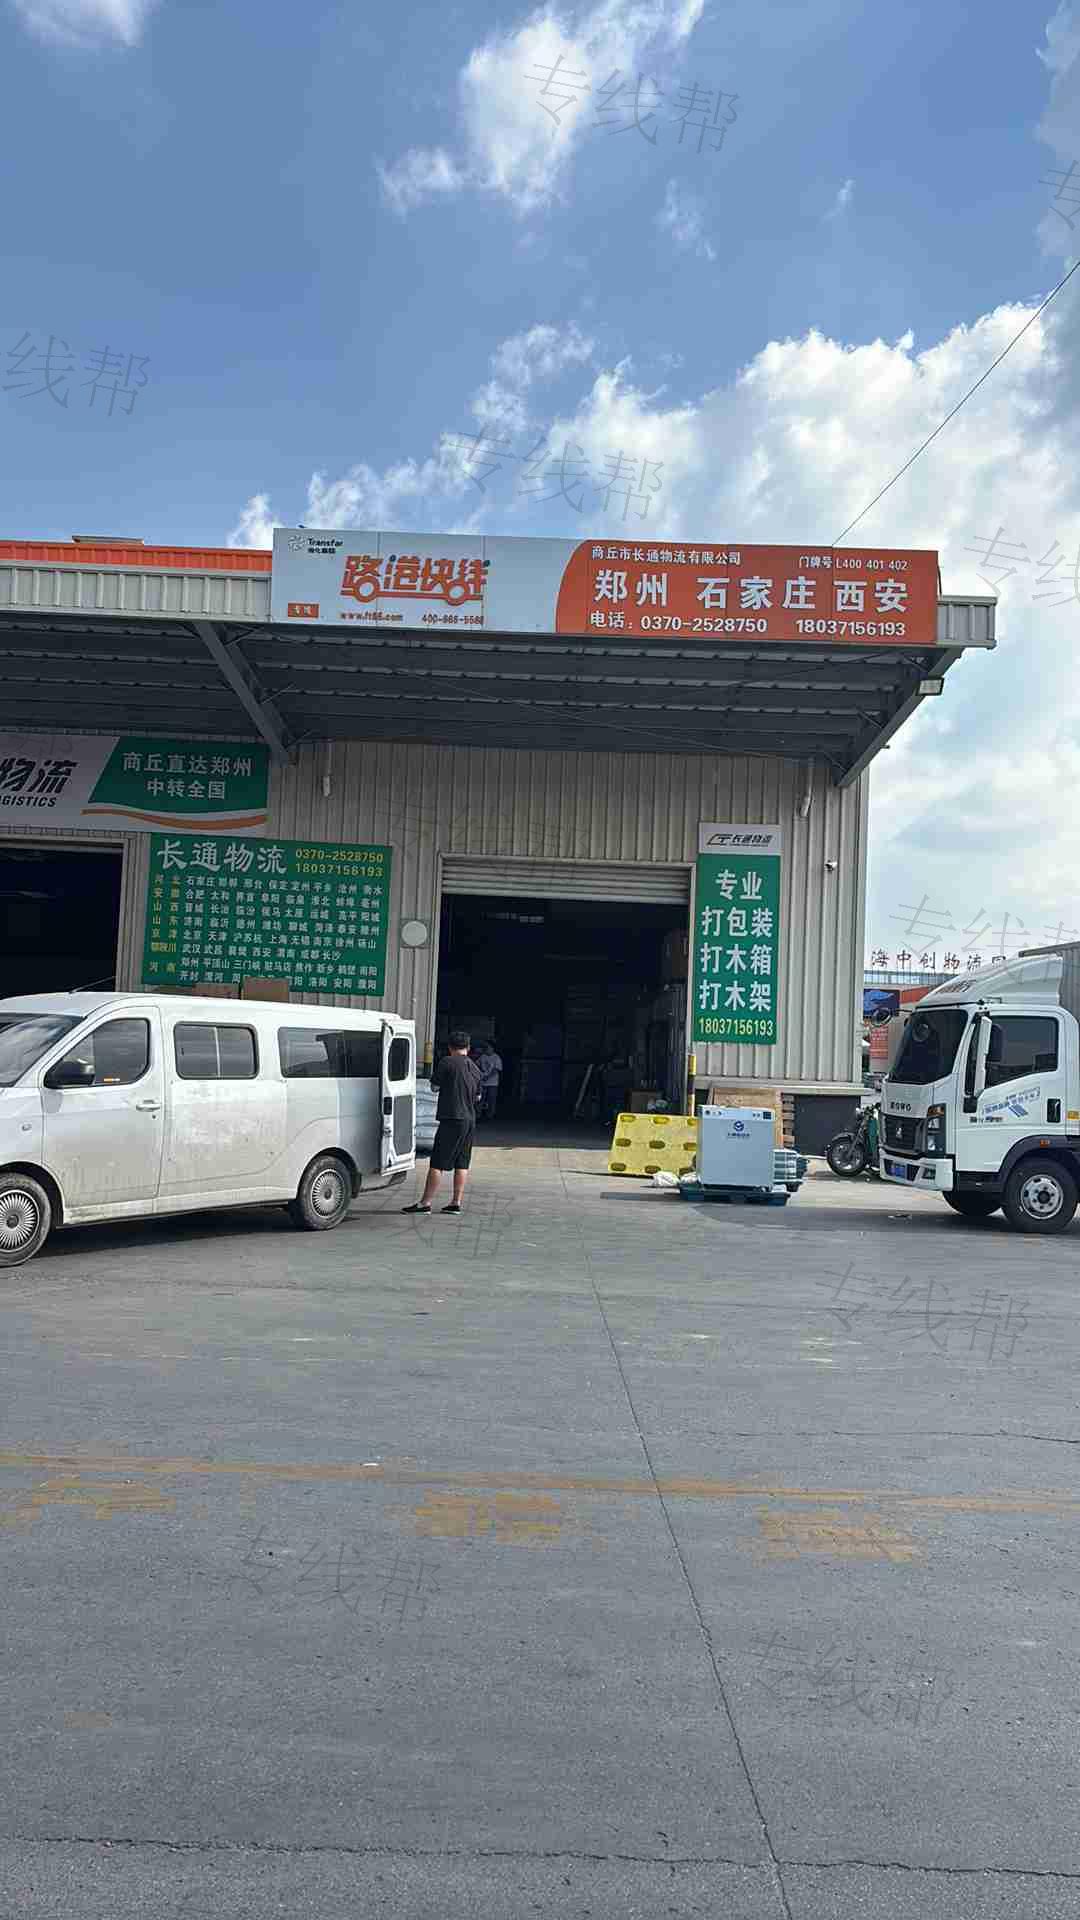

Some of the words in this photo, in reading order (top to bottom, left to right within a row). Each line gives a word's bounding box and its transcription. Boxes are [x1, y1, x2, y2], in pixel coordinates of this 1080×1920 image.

[592, 545, 741, 566] 商丘市长通物流有限公司
[799, 555, 833, 570] 门牌号
[866, 559, 885, 571] 401
[888, 560, 908, 572] 402
[594, 569, 669, 608] 郑州
[696, 575, 816, 611] 石家庄
[833, 579, 908, 615] 西安
[640, 614, 768, 634] 0370-2528750
[797, 618, 906, 637] 18037156193
[122, 751, 253, 777] 商丘直达郑州
[0, 795, 57, 808] GISTICS
[146, 777, 226, 800] 中转全国
[156, 838, 288, 875] 长通物流
[715, 868, 763, 900] 专业
[701, 906, 773, 938] 打包装
[699, 942, 773, 976] 打木箱
[699, 979, 771, 1012] 打木架
[698, 1017, 774, 1037] 18037156193
